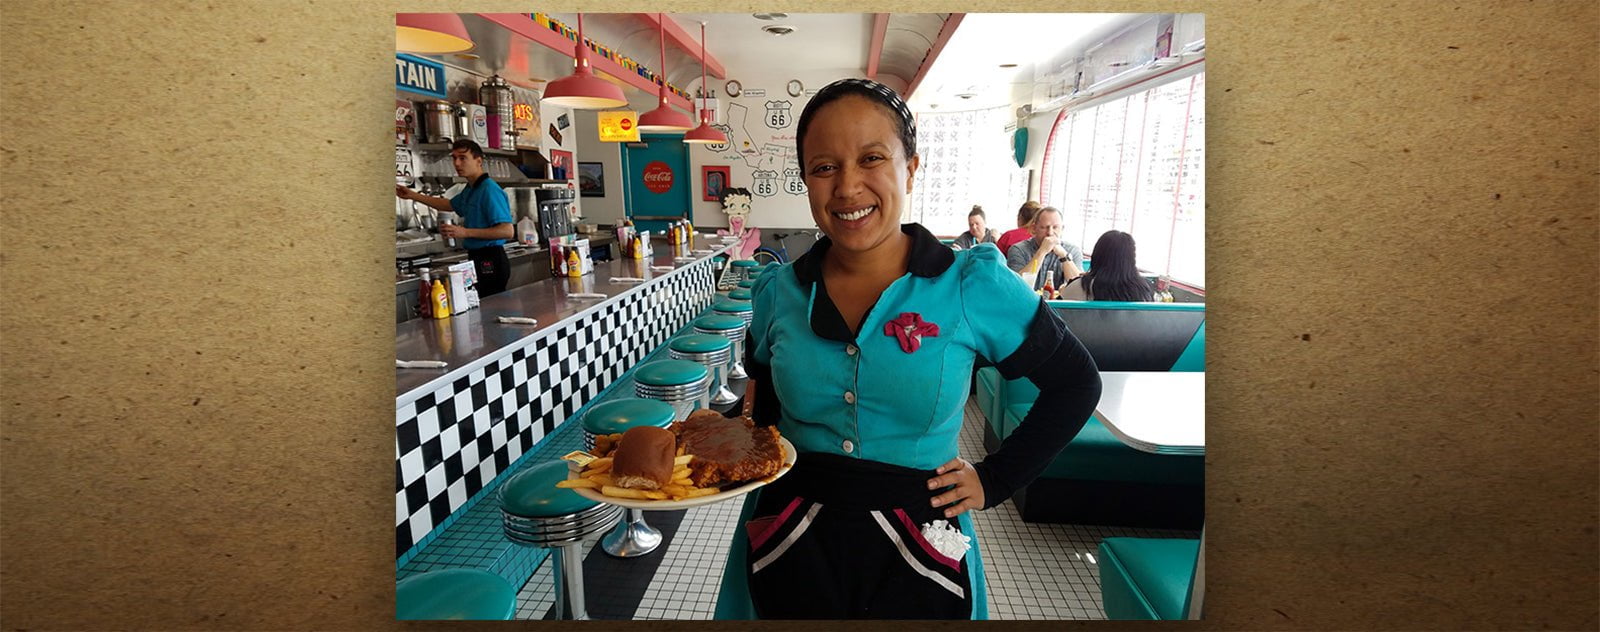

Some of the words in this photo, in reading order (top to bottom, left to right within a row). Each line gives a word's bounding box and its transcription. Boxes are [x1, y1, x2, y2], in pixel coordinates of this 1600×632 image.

[396, 59, 437, 91] TAIN
[771, 114, 785, 126] 66
[758, 183, 772, 194] 66
[789, 181, 803, 192] 66
